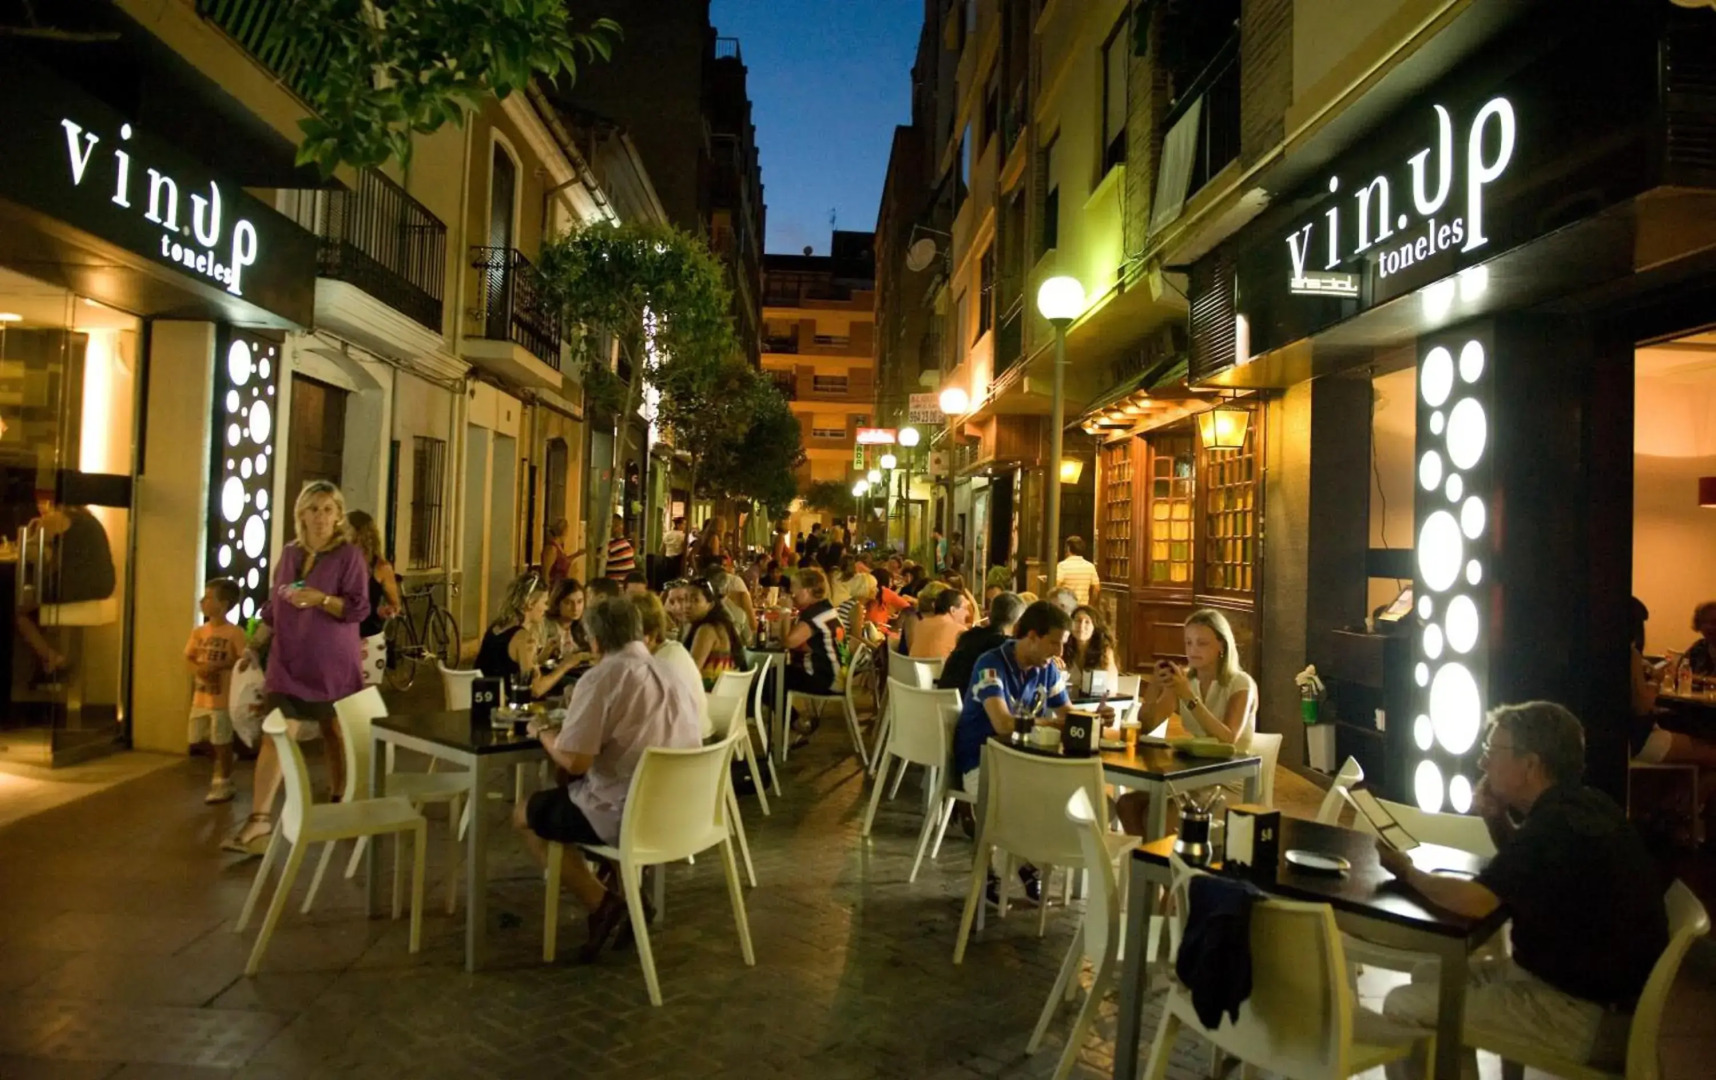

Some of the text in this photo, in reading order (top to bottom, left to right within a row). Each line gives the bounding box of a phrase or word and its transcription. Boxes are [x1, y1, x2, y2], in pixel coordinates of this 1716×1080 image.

[161, 234, 234, 285] toneles
[1379, 217, 1464, 279] toneles
[474, 691, 493, 703] 59
[1070, 726, 1085, 739] 60
